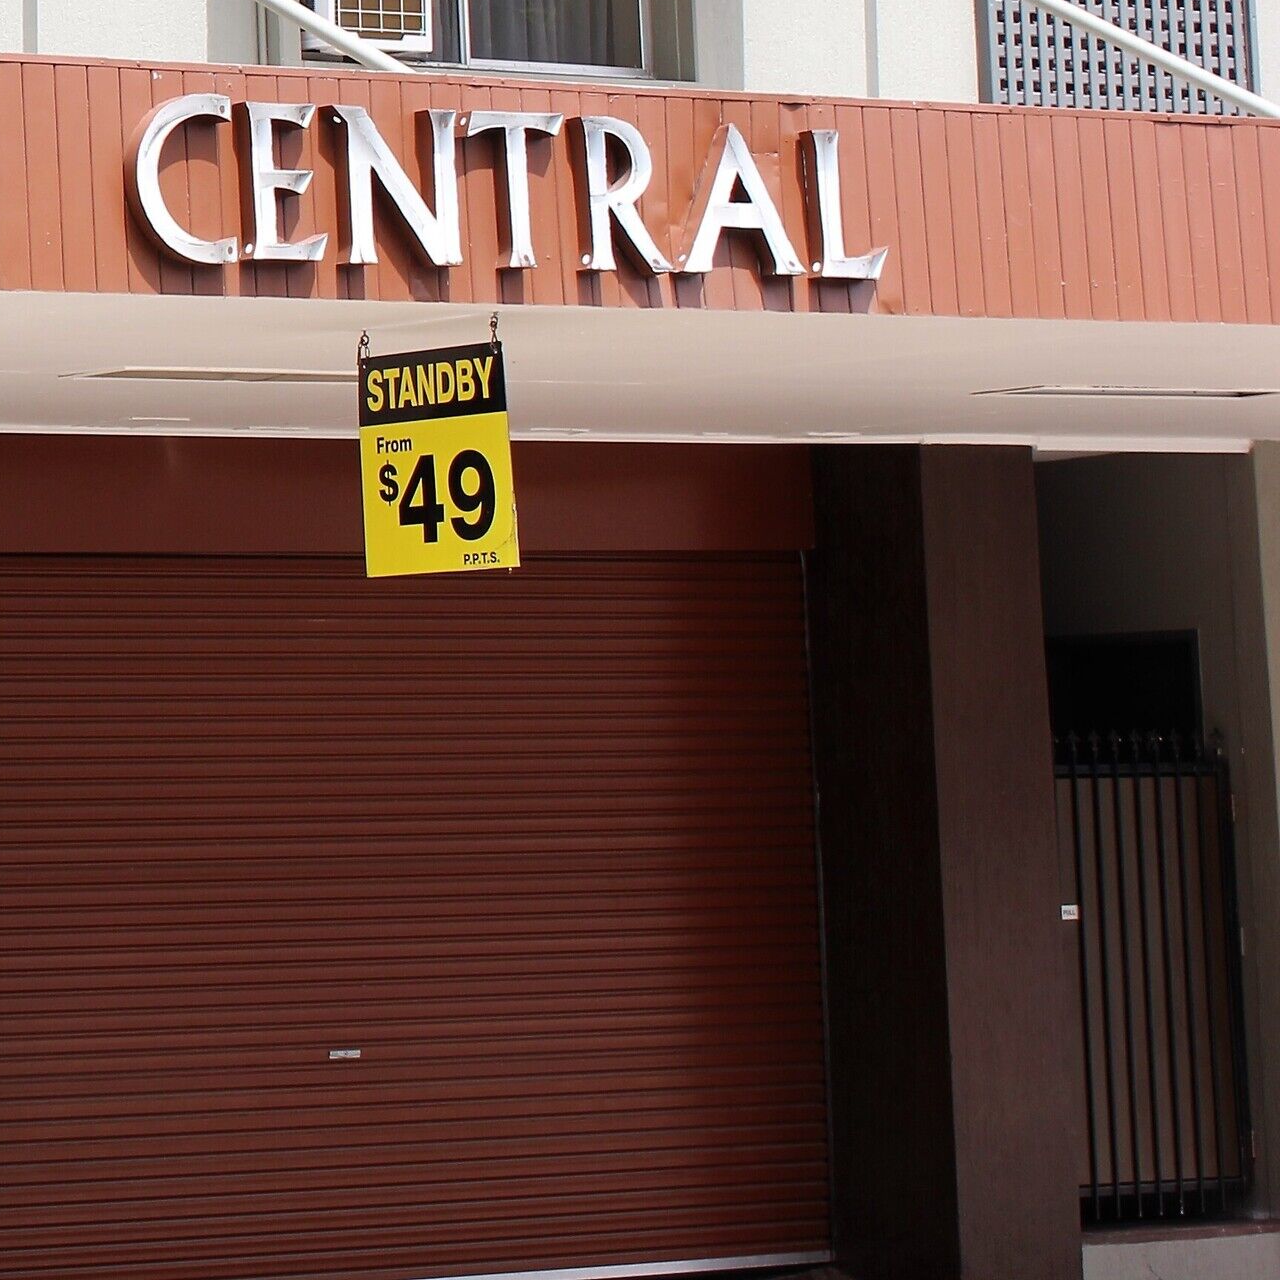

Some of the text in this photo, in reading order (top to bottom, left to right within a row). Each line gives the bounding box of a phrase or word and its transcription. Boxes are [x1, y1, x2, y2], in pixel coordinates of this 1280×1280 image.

[128, 93, 889, 280] CENTRAL
[367, 356, 494, 412] STANDBY
[377, 437, 412, 454] From
[378, 449, 496, 543] $49
[463, 551, 501, 566] P.P.T.S.
